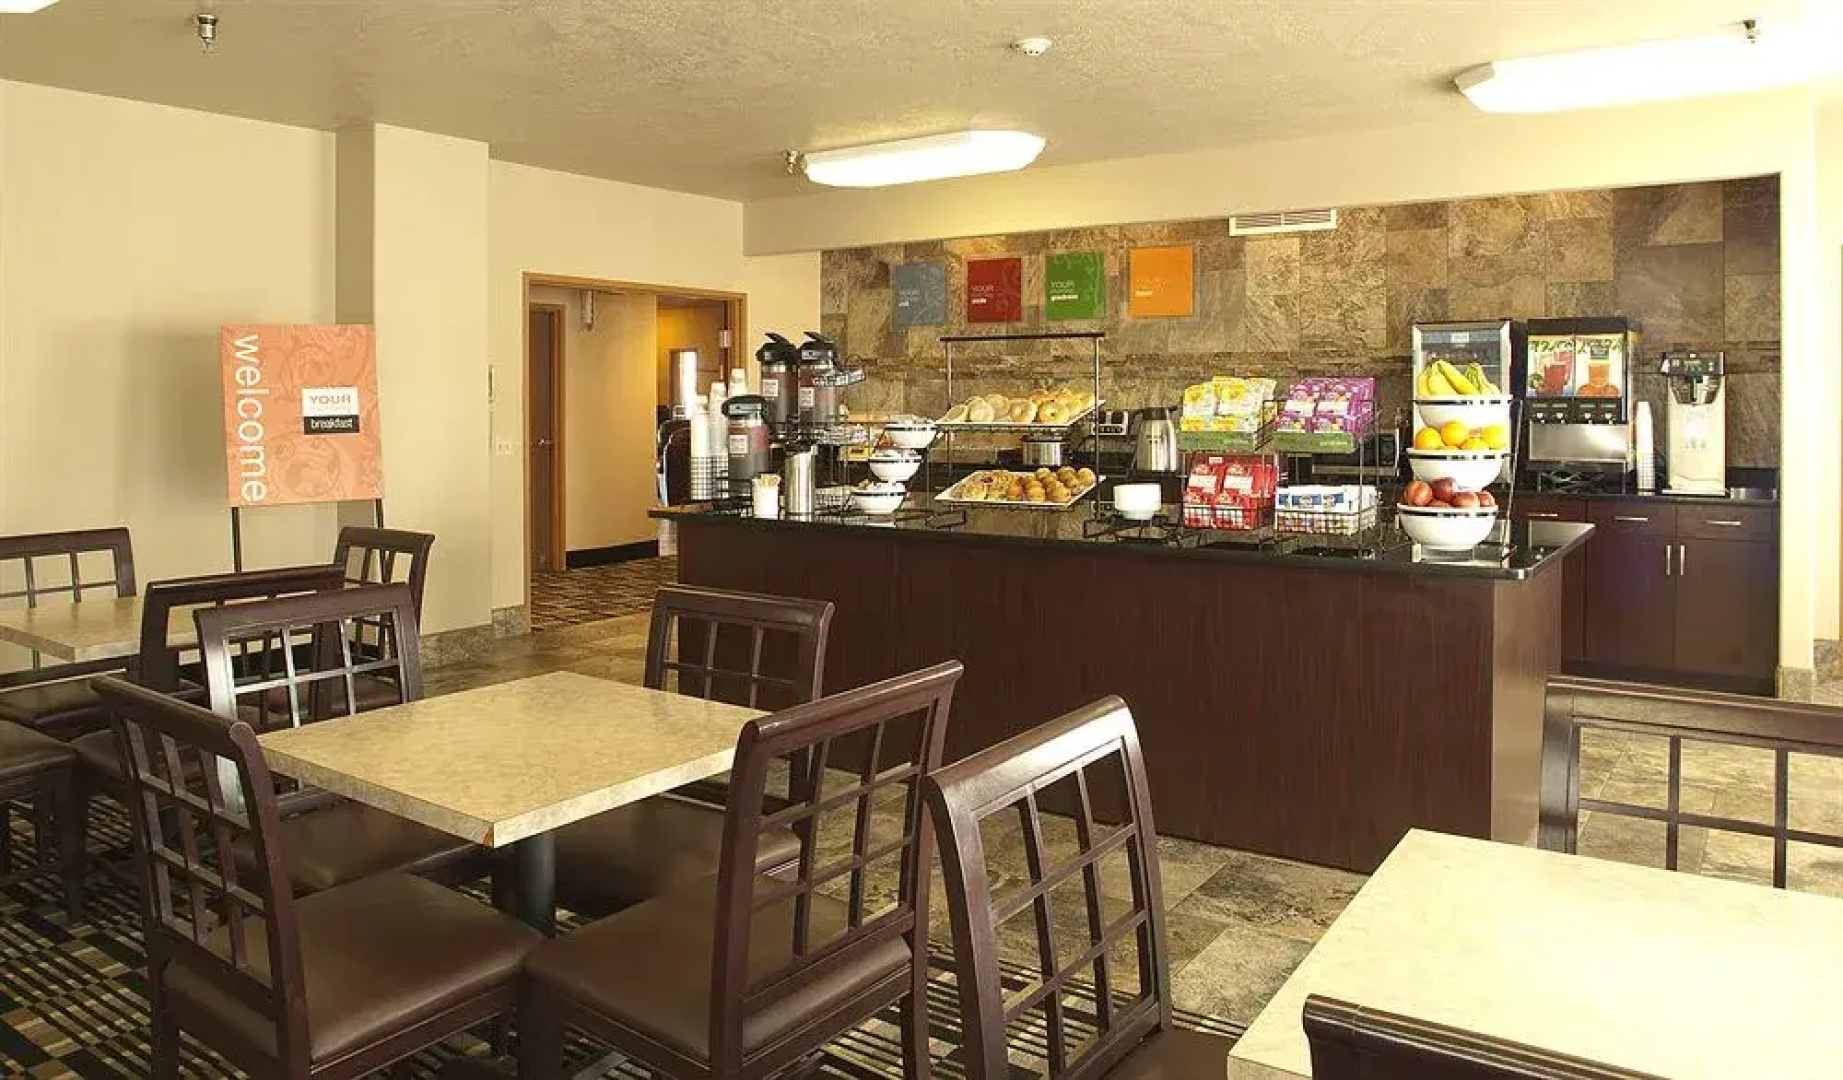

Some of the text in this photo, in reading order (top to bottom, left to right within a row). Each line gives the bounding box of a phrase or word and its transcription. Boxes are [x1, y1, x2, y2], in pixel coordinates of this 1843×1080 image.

[309, 394, 351, 404] YOUR
[234, 334, 268, 502] welcome
[310, 417, 353, 430] breakfast
